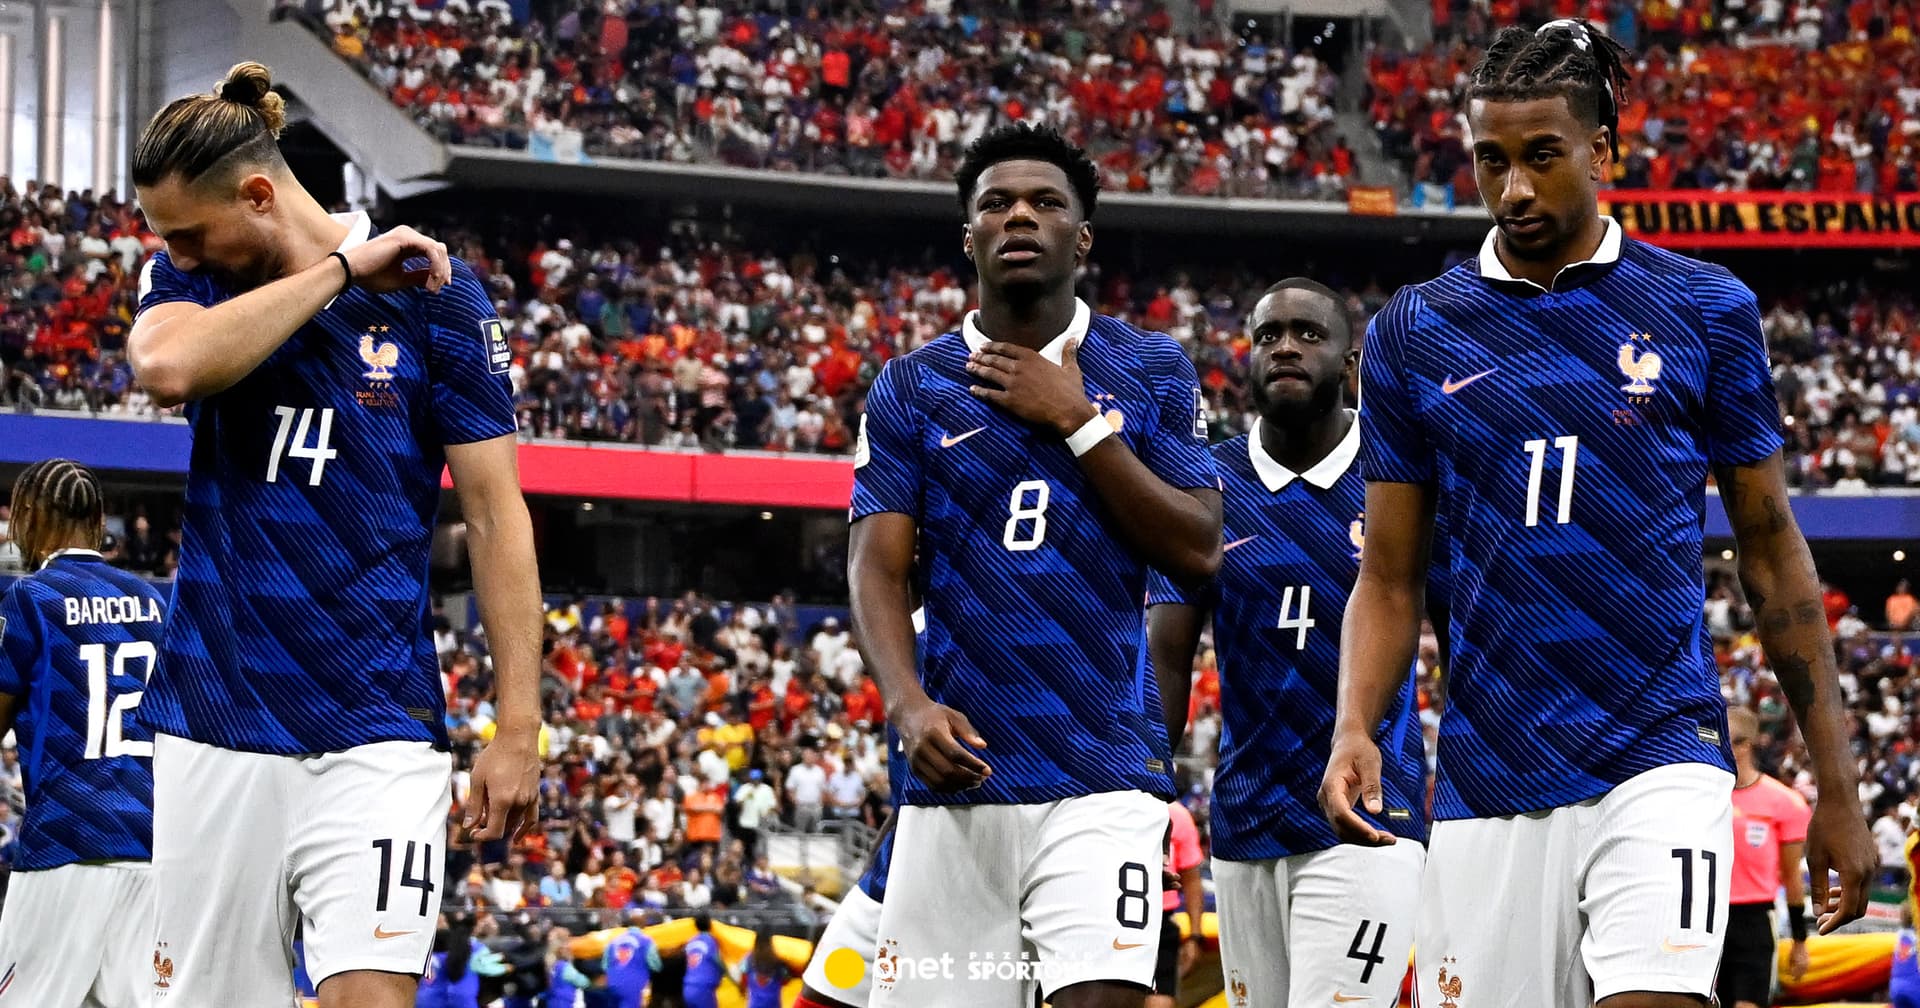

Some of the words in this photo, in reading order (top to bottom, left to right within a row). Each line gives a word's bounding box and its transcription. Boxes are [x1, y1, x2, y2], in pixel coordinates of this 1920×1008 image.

[1612, 201, 1745, 233] FURIA
[266, 405, 337, 486] 14
[1523, 435, 1578, 527] 11
[1003, 479, 1050, 552] 8
[64, 595, 162, 626] BARCOLA
[1277, 585, 1315, 650] 4
[79, 640, 158, 760] 12
[372, 838, 435, 917] 14
[1116, 861, 1150, 930] 8
[1671, 848, 1718, 934] 11
[1346, 919, 1388, 984] 4
